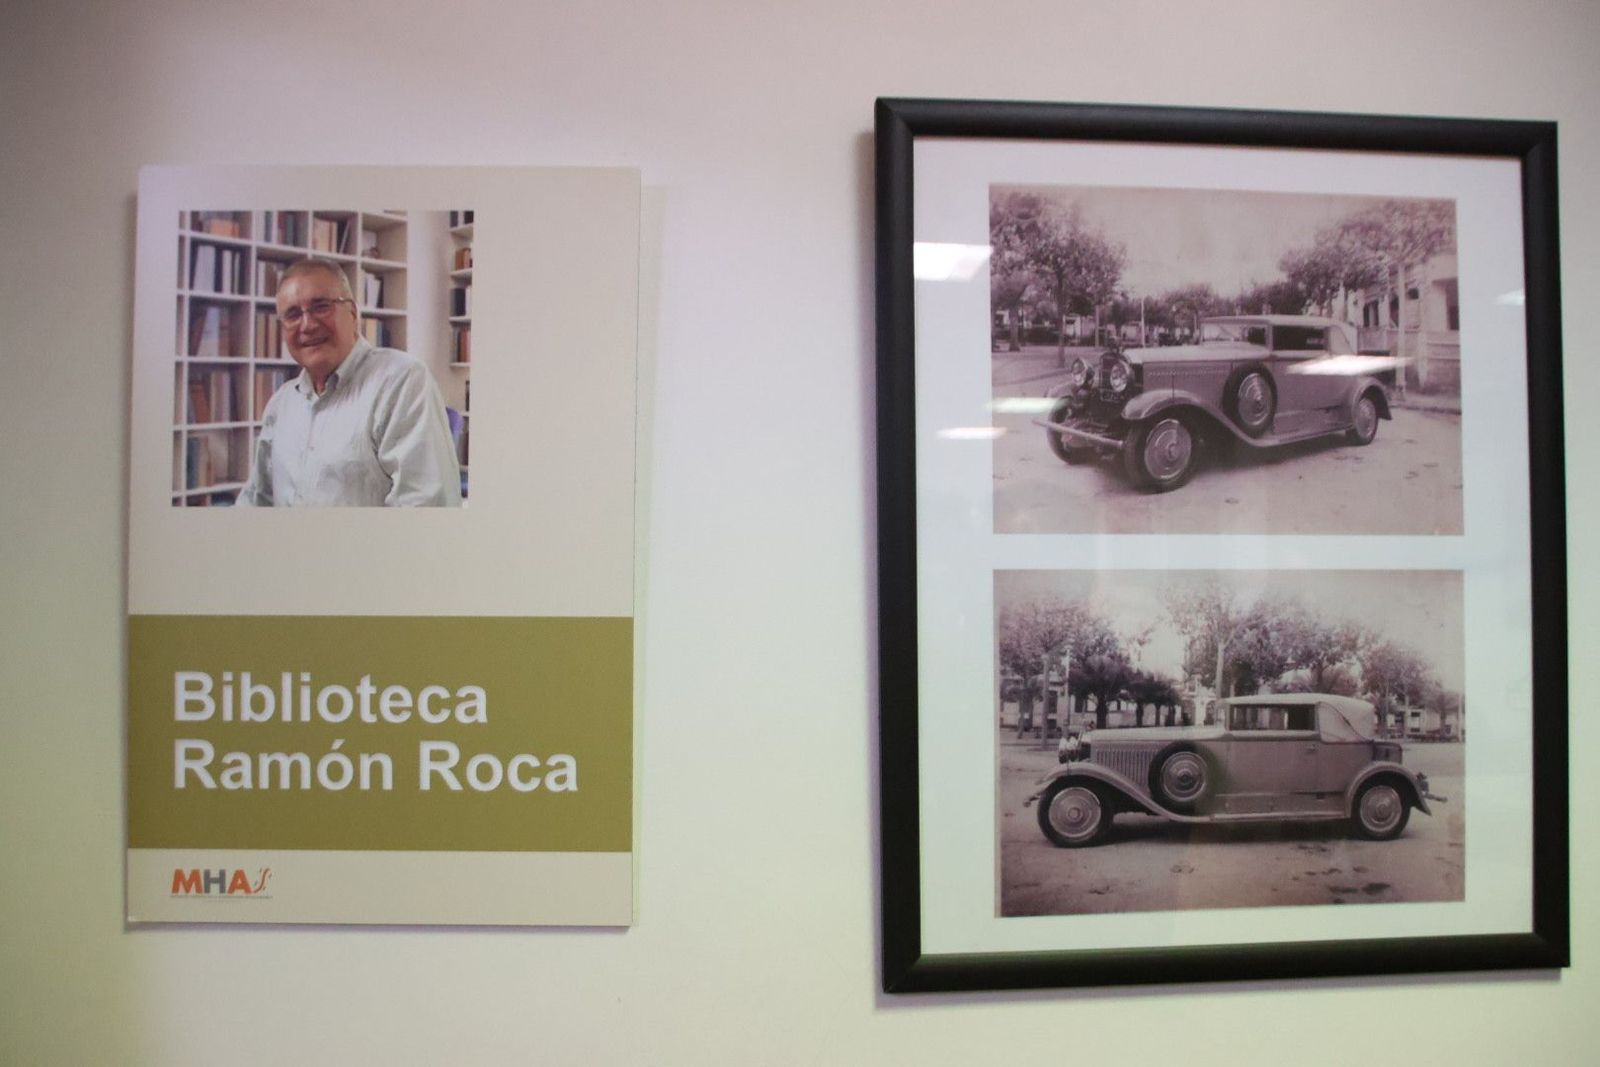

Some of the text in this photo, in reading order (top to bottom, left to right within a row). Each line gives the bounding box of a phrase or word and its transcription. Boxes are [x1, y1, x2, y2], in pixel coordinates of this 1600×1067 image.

[174, 671, 488, 724] Biblioteca
[174, 739, 579, 793] Ramón Roca
[171, 868, 252, 895] MHA
